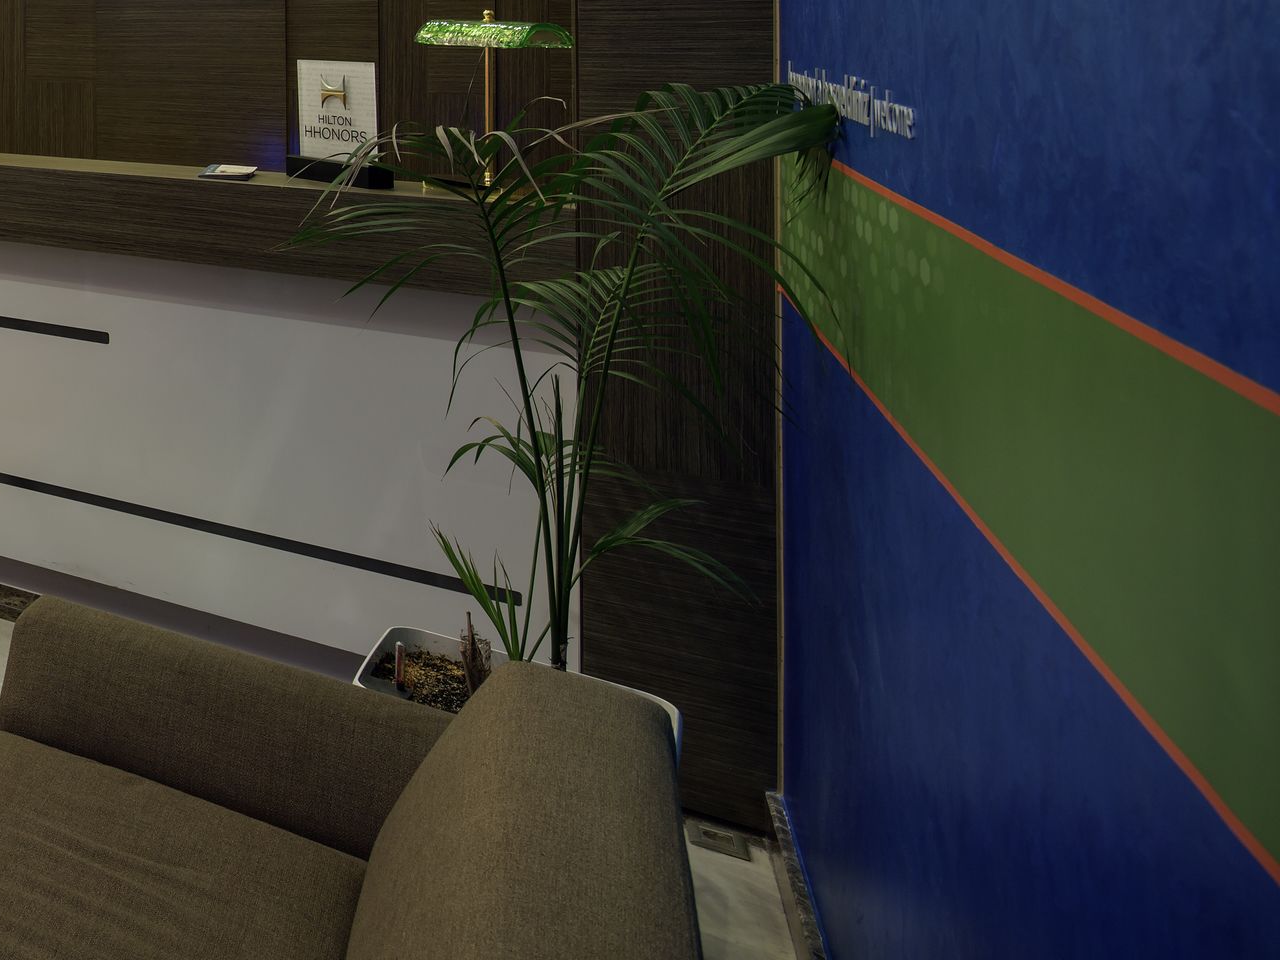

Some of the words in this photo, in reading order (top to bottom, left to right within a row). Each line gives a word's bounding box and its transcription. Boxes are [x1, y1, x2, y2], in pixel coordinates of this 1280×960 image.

[318, 114, 352, 126] HILTON
[874, 89, 913, 140] welcome
[304, 125, 368, 144] HHONORS
